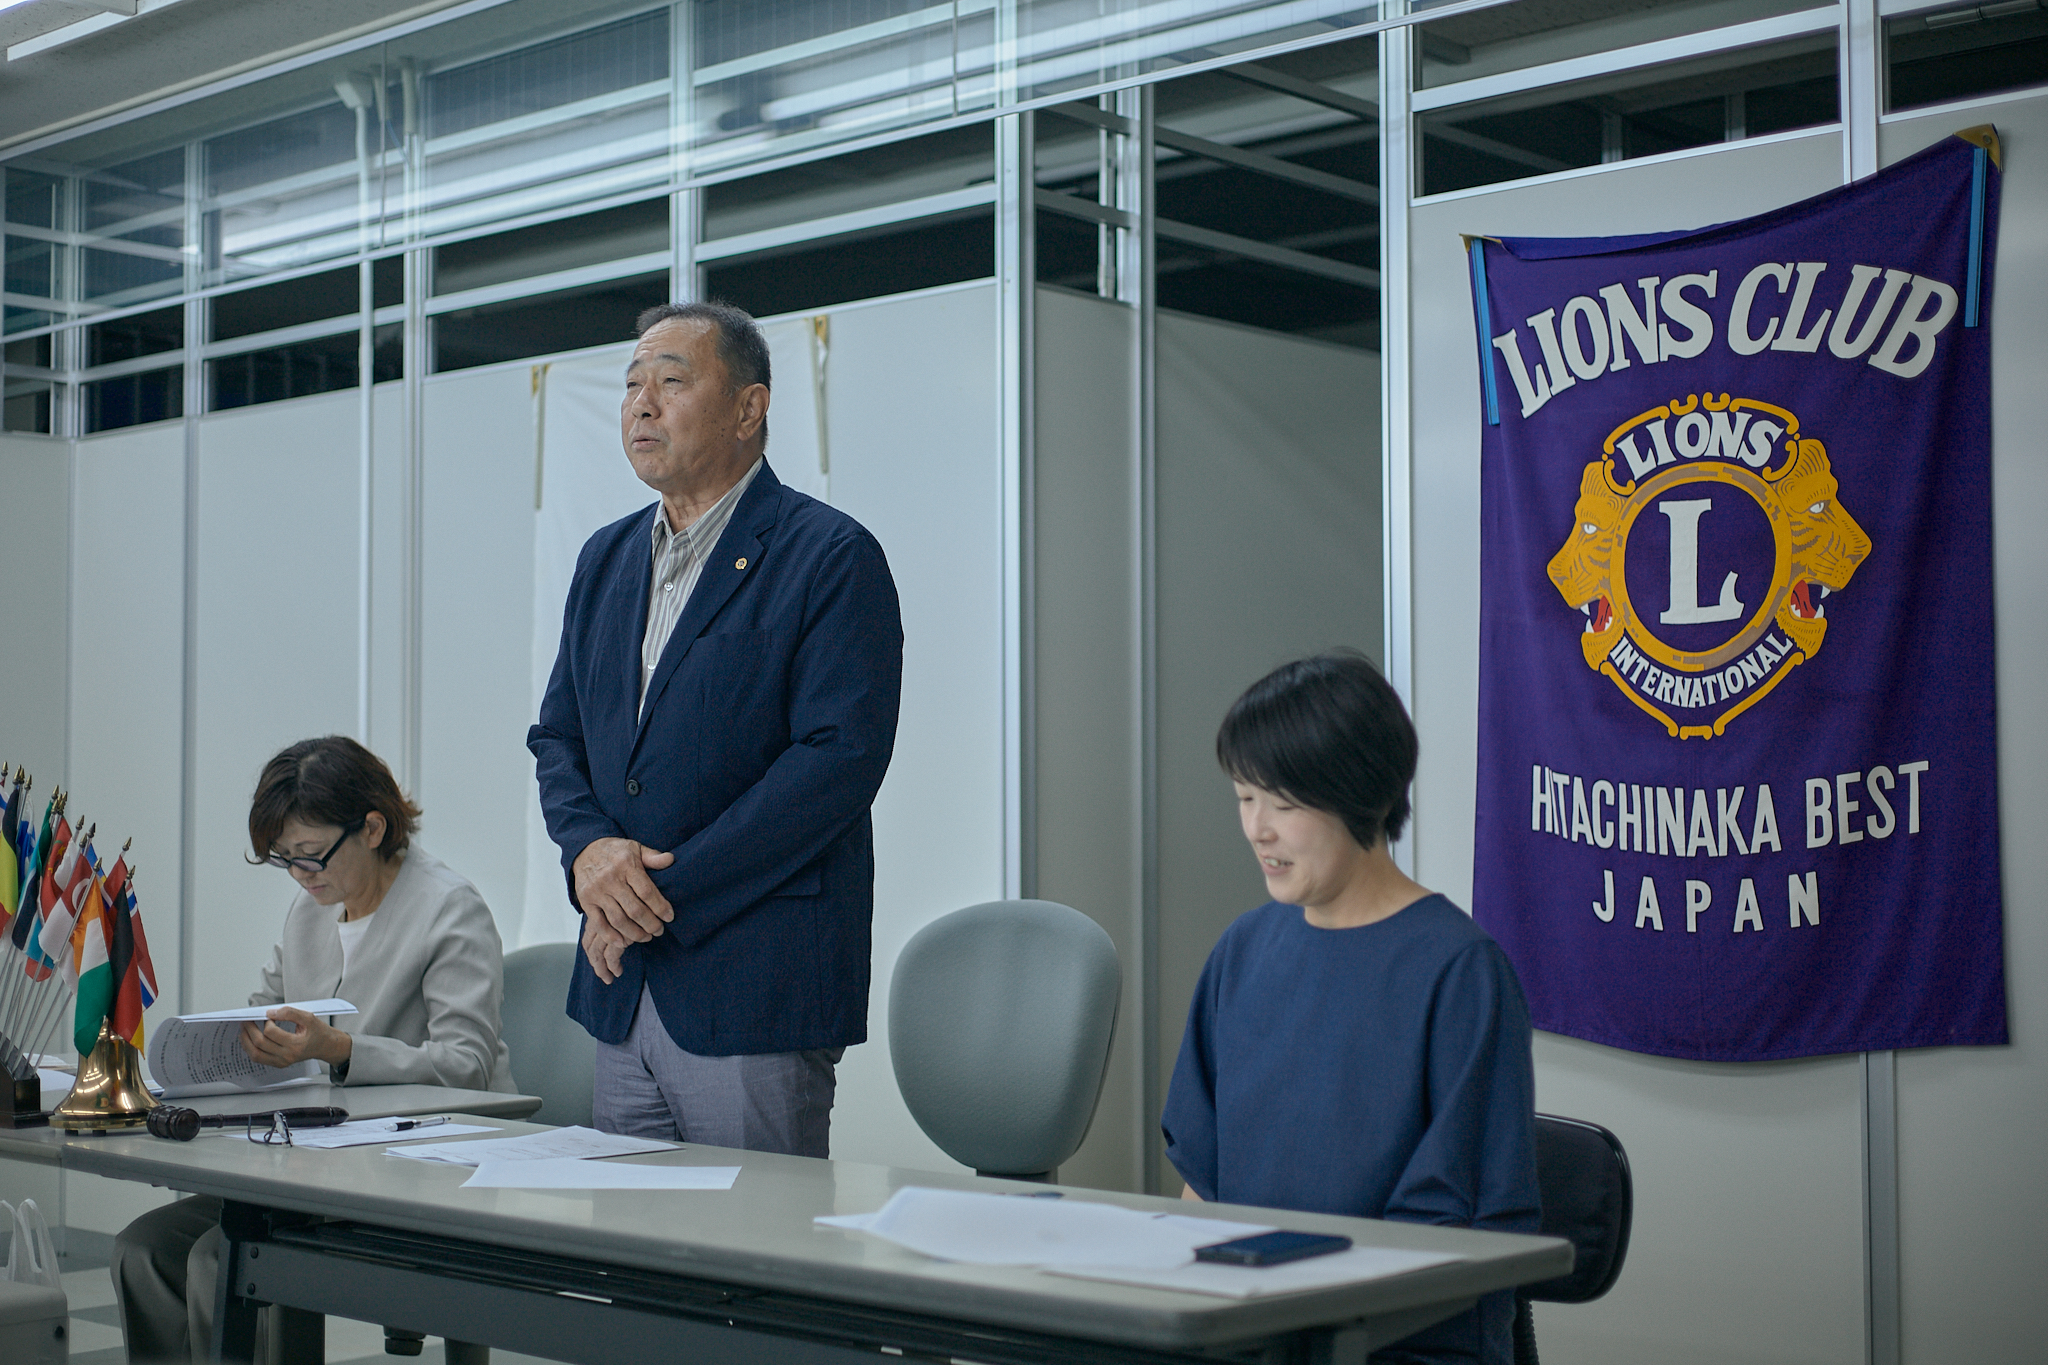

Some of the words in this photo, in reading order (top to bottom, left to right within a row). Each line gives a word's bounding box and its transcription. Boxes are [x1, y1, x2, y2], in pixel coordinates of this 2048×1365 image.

[1492, 269, 1718, 418] LIONS
[1727, 262, 1959, 378] CLUB
[1616, 411, 1783, 481] LIONS
[1659, 498, 1744, 625] L
[1609, 632, 1793, 708] INTERNATIONAL
[1805, 760, 1929, 849] BEST
[1593, 869, 1820, 933] JAPAN
